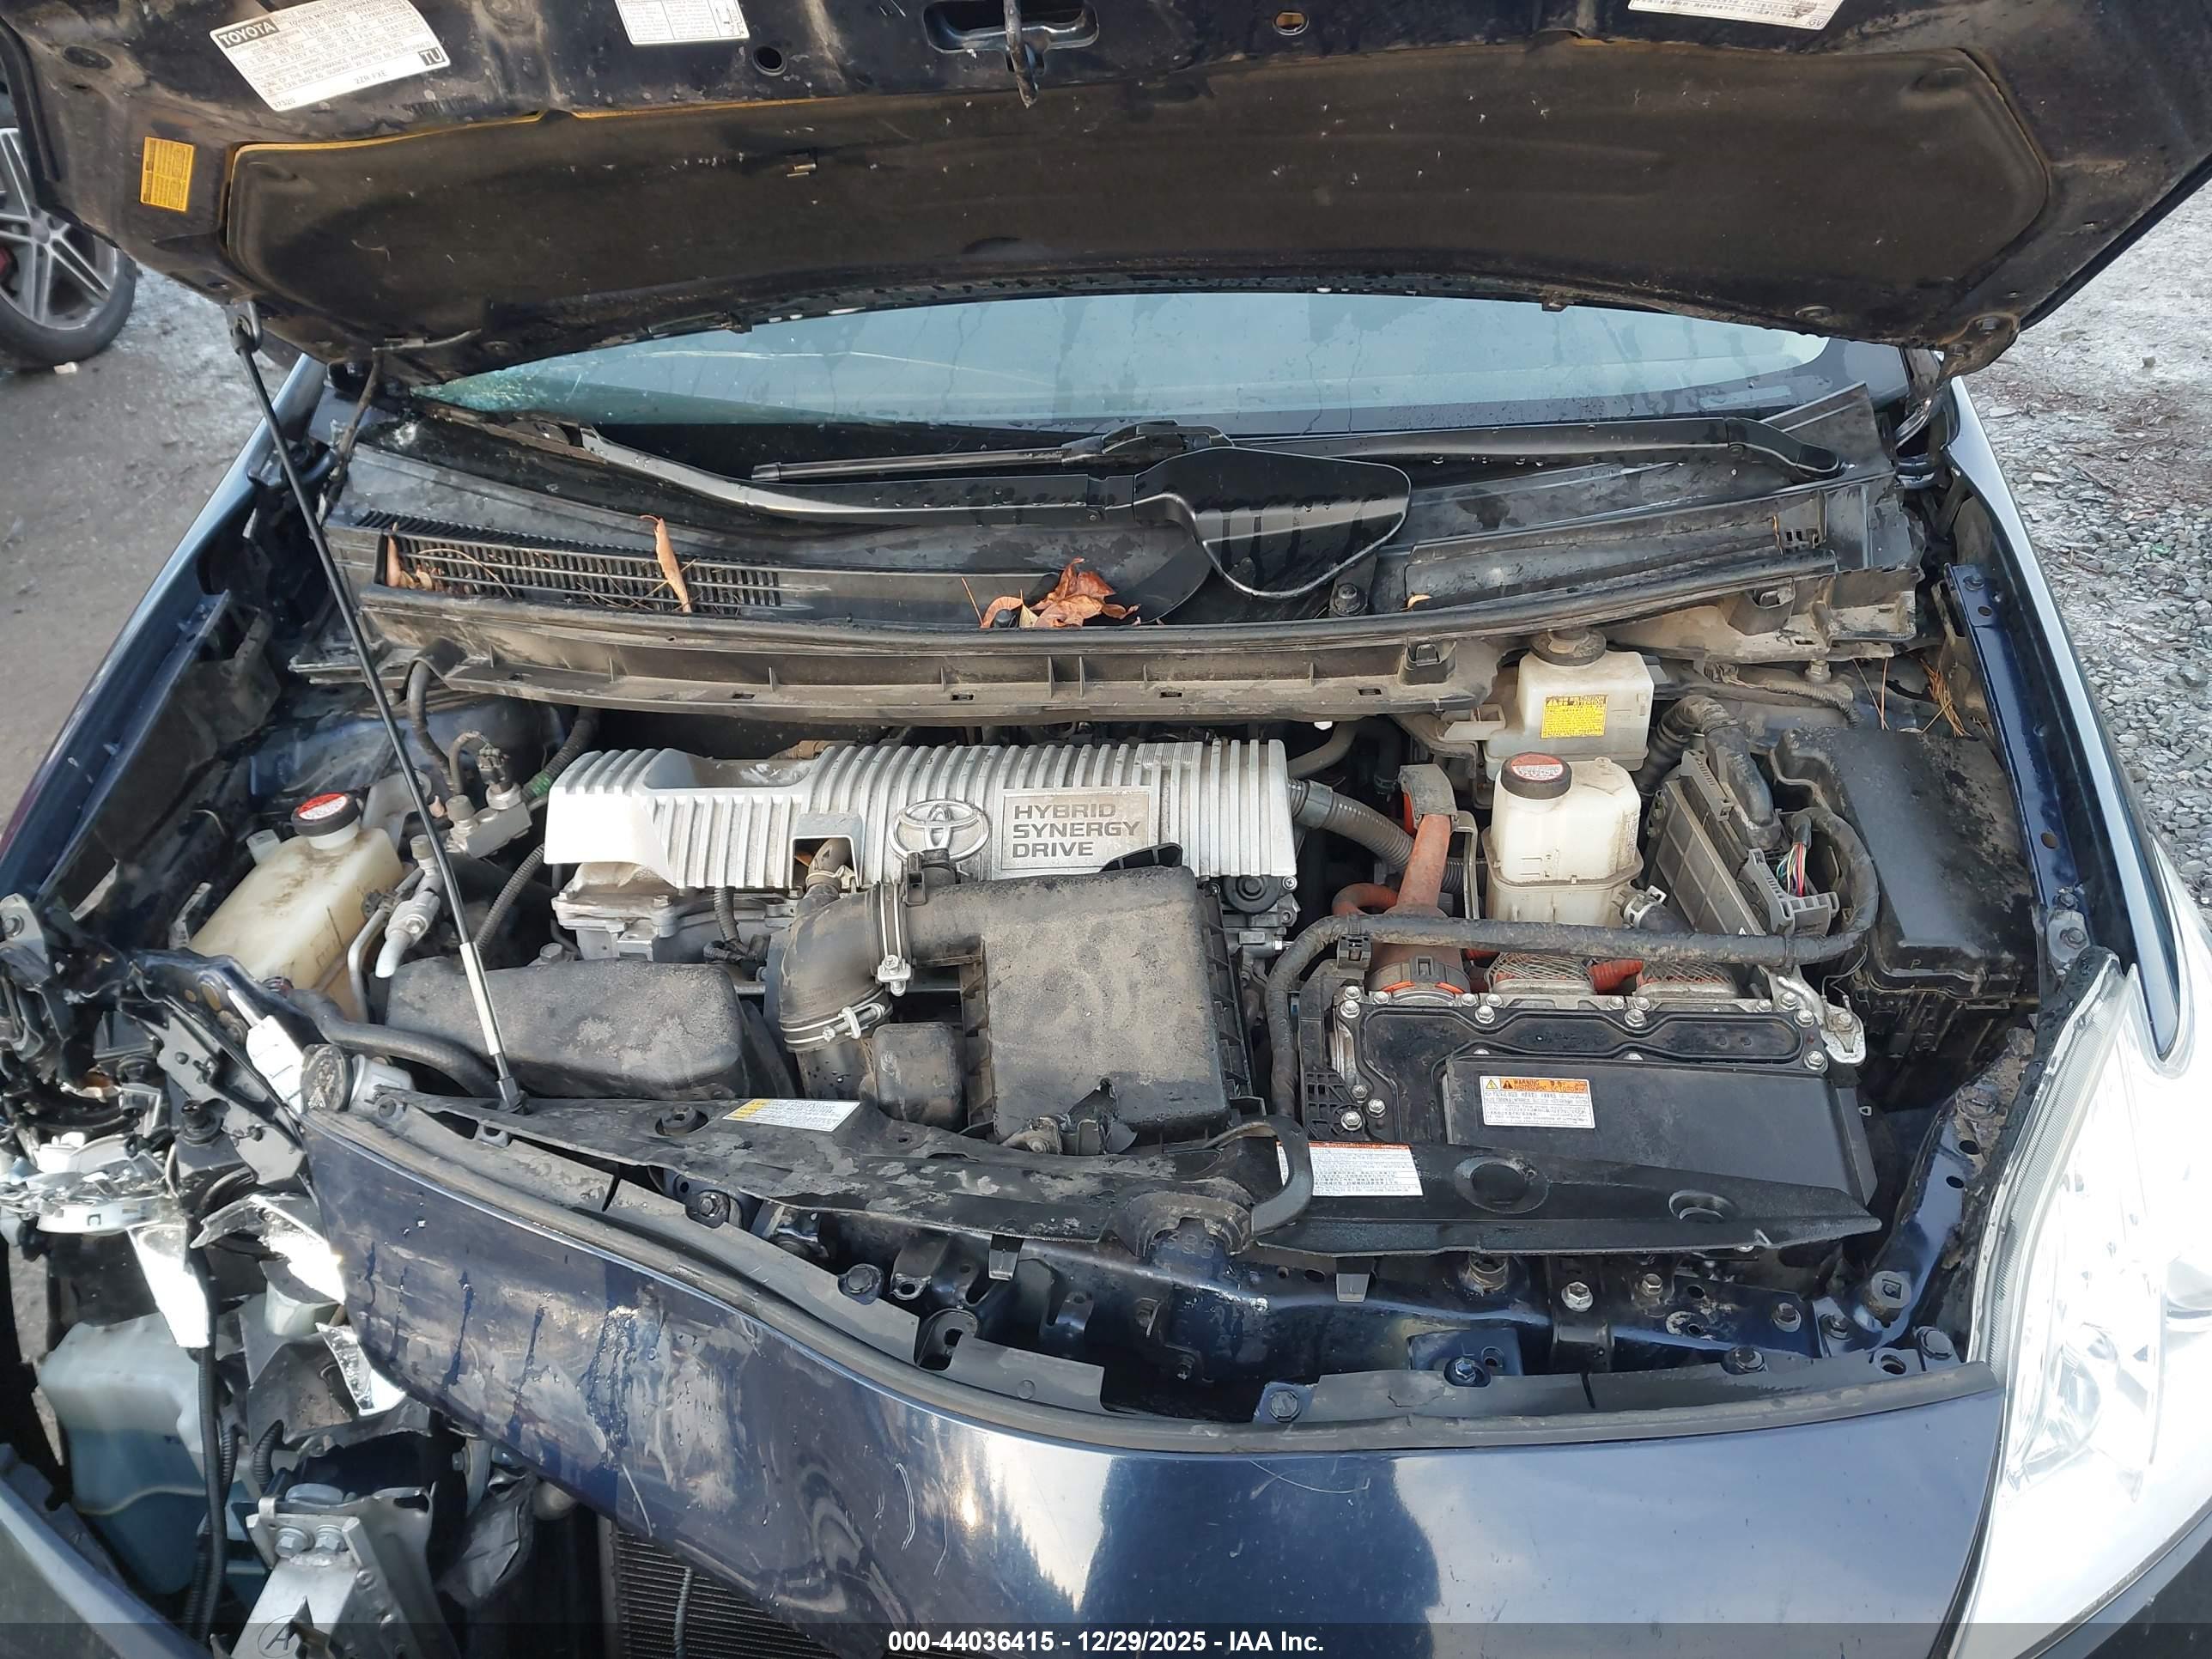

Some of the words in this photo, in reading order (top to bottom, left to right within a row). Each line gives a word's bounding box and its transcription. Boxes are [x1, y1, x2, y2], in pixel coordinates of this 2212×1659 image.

[218, 21, 276, 46] TOYOTA
[419, 48, 443, 64] TU
[1014, 803, 1116, 820] HYBRID
[1012, 821, 1140, 839] SYNERGY
[1012, 842, 1094, 858] DRIVE
